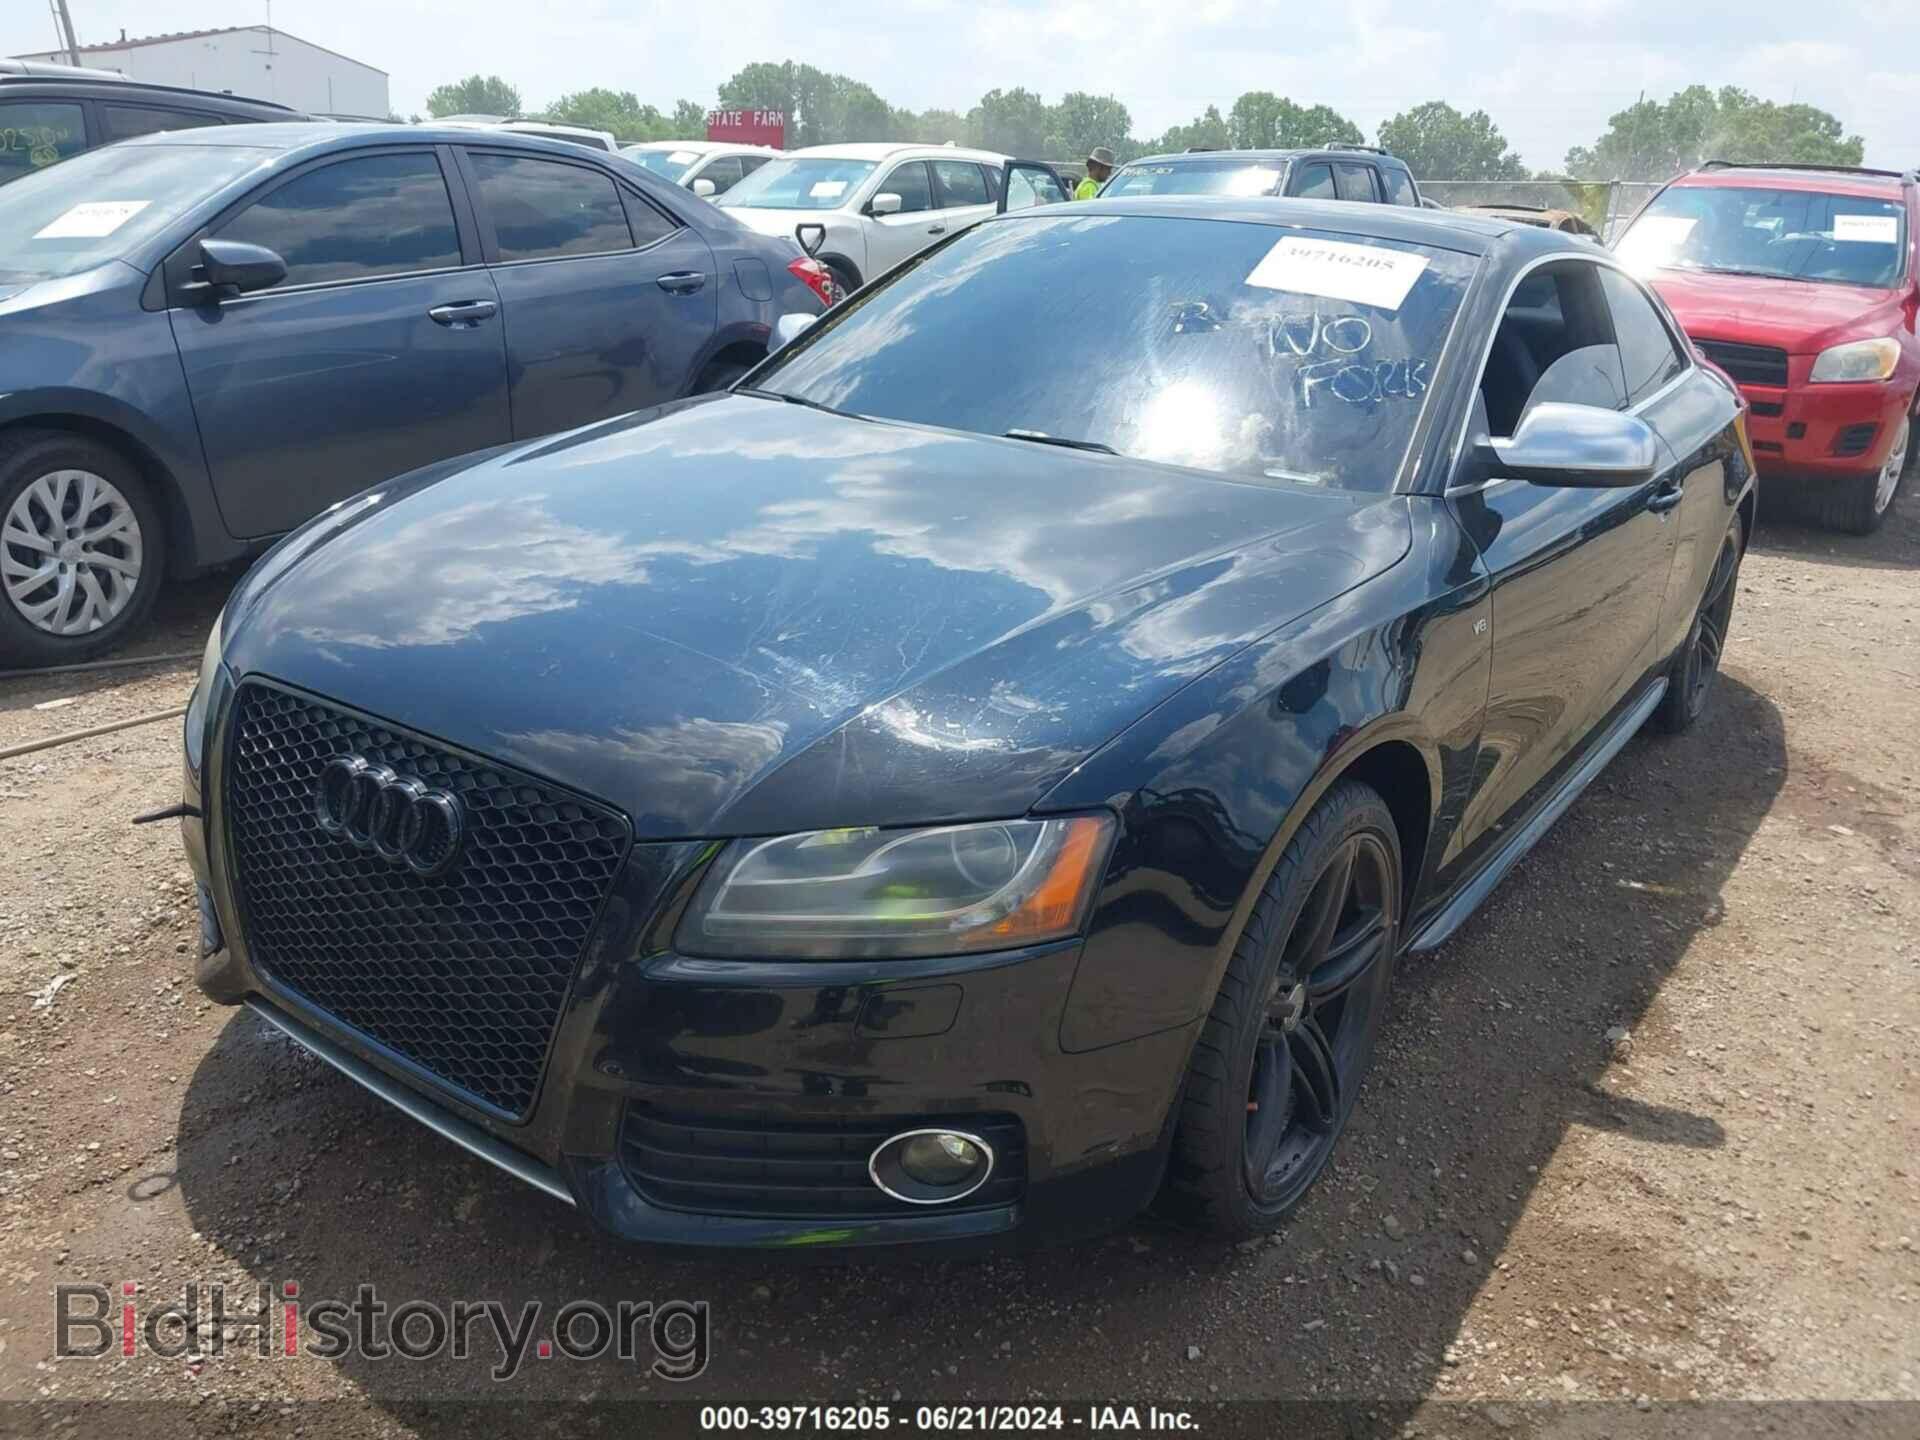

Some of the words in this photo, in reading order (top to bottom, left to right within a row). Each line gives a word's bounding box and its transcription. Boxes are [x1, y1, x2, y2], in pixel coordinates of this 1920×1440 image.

[708, 111, 743, 126] STATE
[753, 111, 784, 127] FARM
[1268, 312, 1372, 356] NO
[1473, 618, 1488, 635] V8
